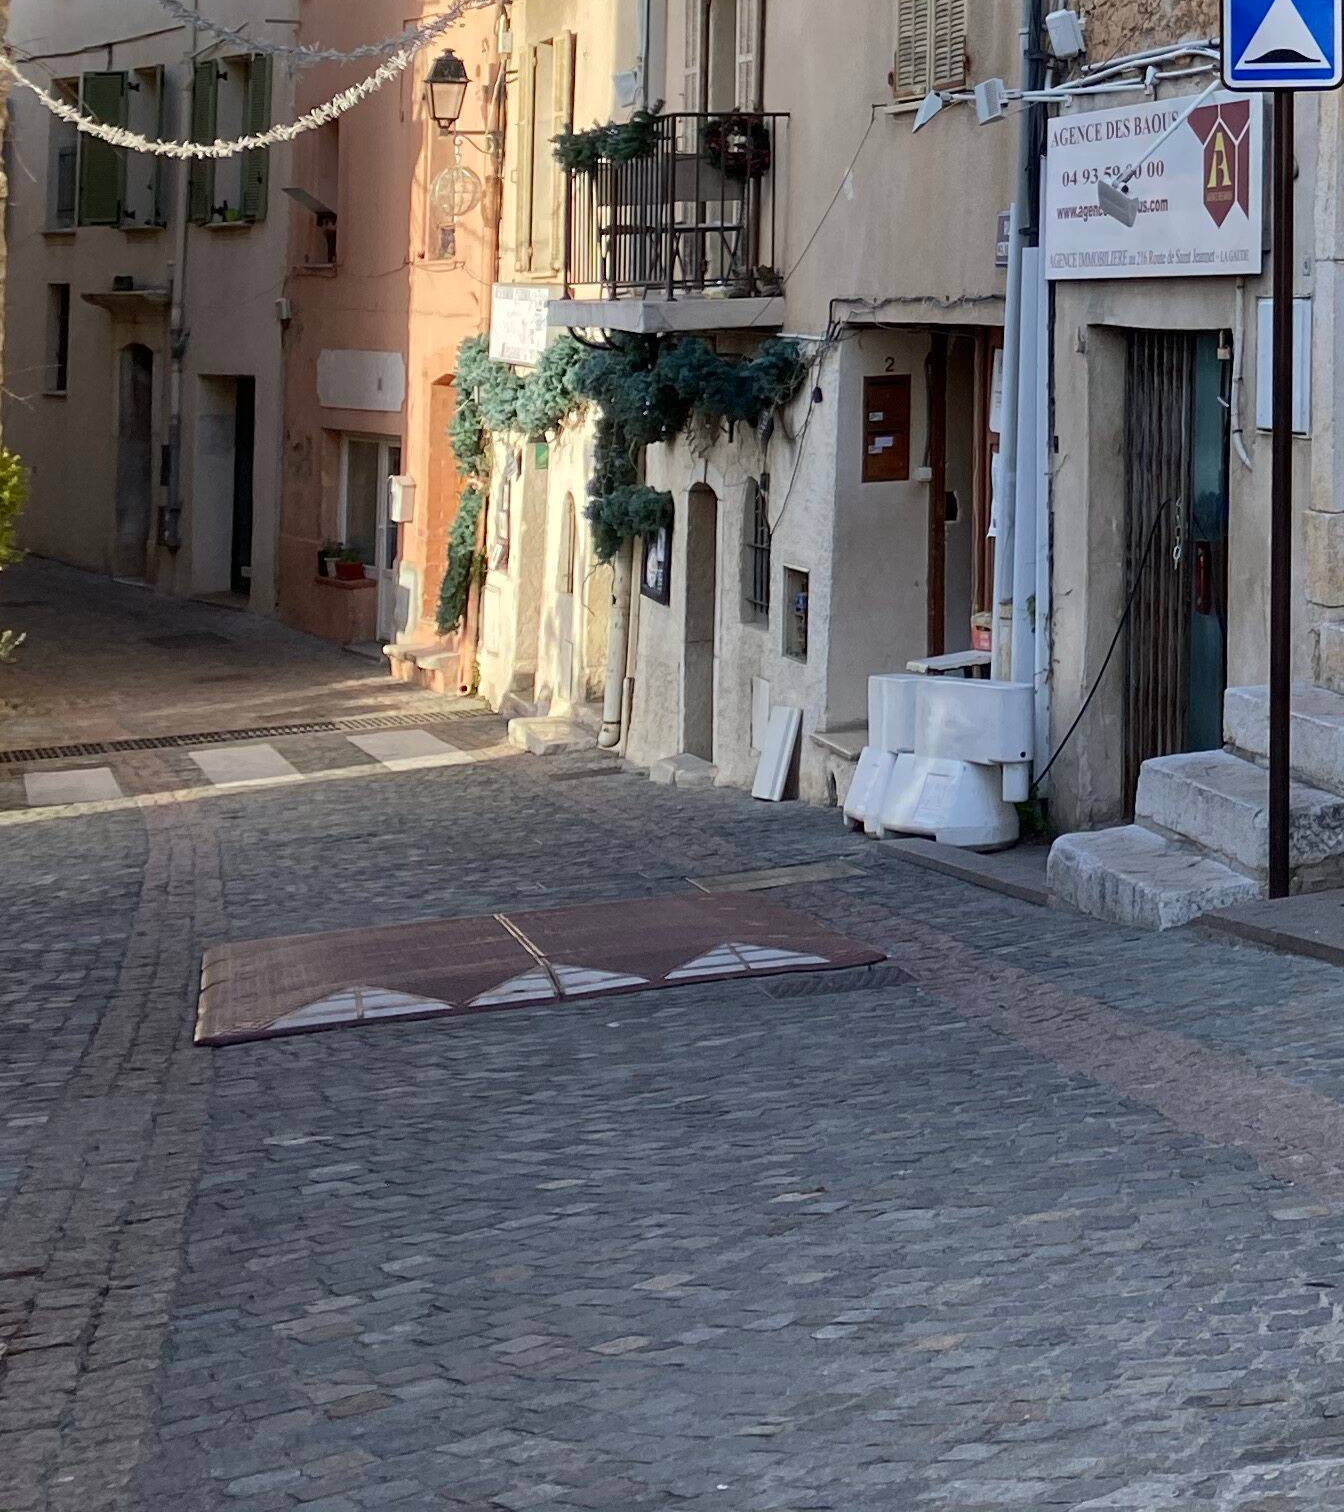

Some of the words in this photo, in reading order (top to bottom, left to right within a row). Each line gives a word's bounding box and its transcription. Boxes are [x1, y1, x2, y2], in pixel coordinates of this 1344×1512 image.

[1051, 123, 1102, 148] AGENCE
[1106, 119, 1131, 139] DES
[1134, 111, 1180, 136] BAOUS
[1062, 170, 1077, 187] 04
[1082, 168, 1098, 184] 93
[1147, 160, 1164, 177] 00
[1050, 253, 1077, 268] AGENCE
[1149, 250, 1165, 265] Route
[1167, 248, 1174, 264] de
[884, 356, 895, 372] 2
